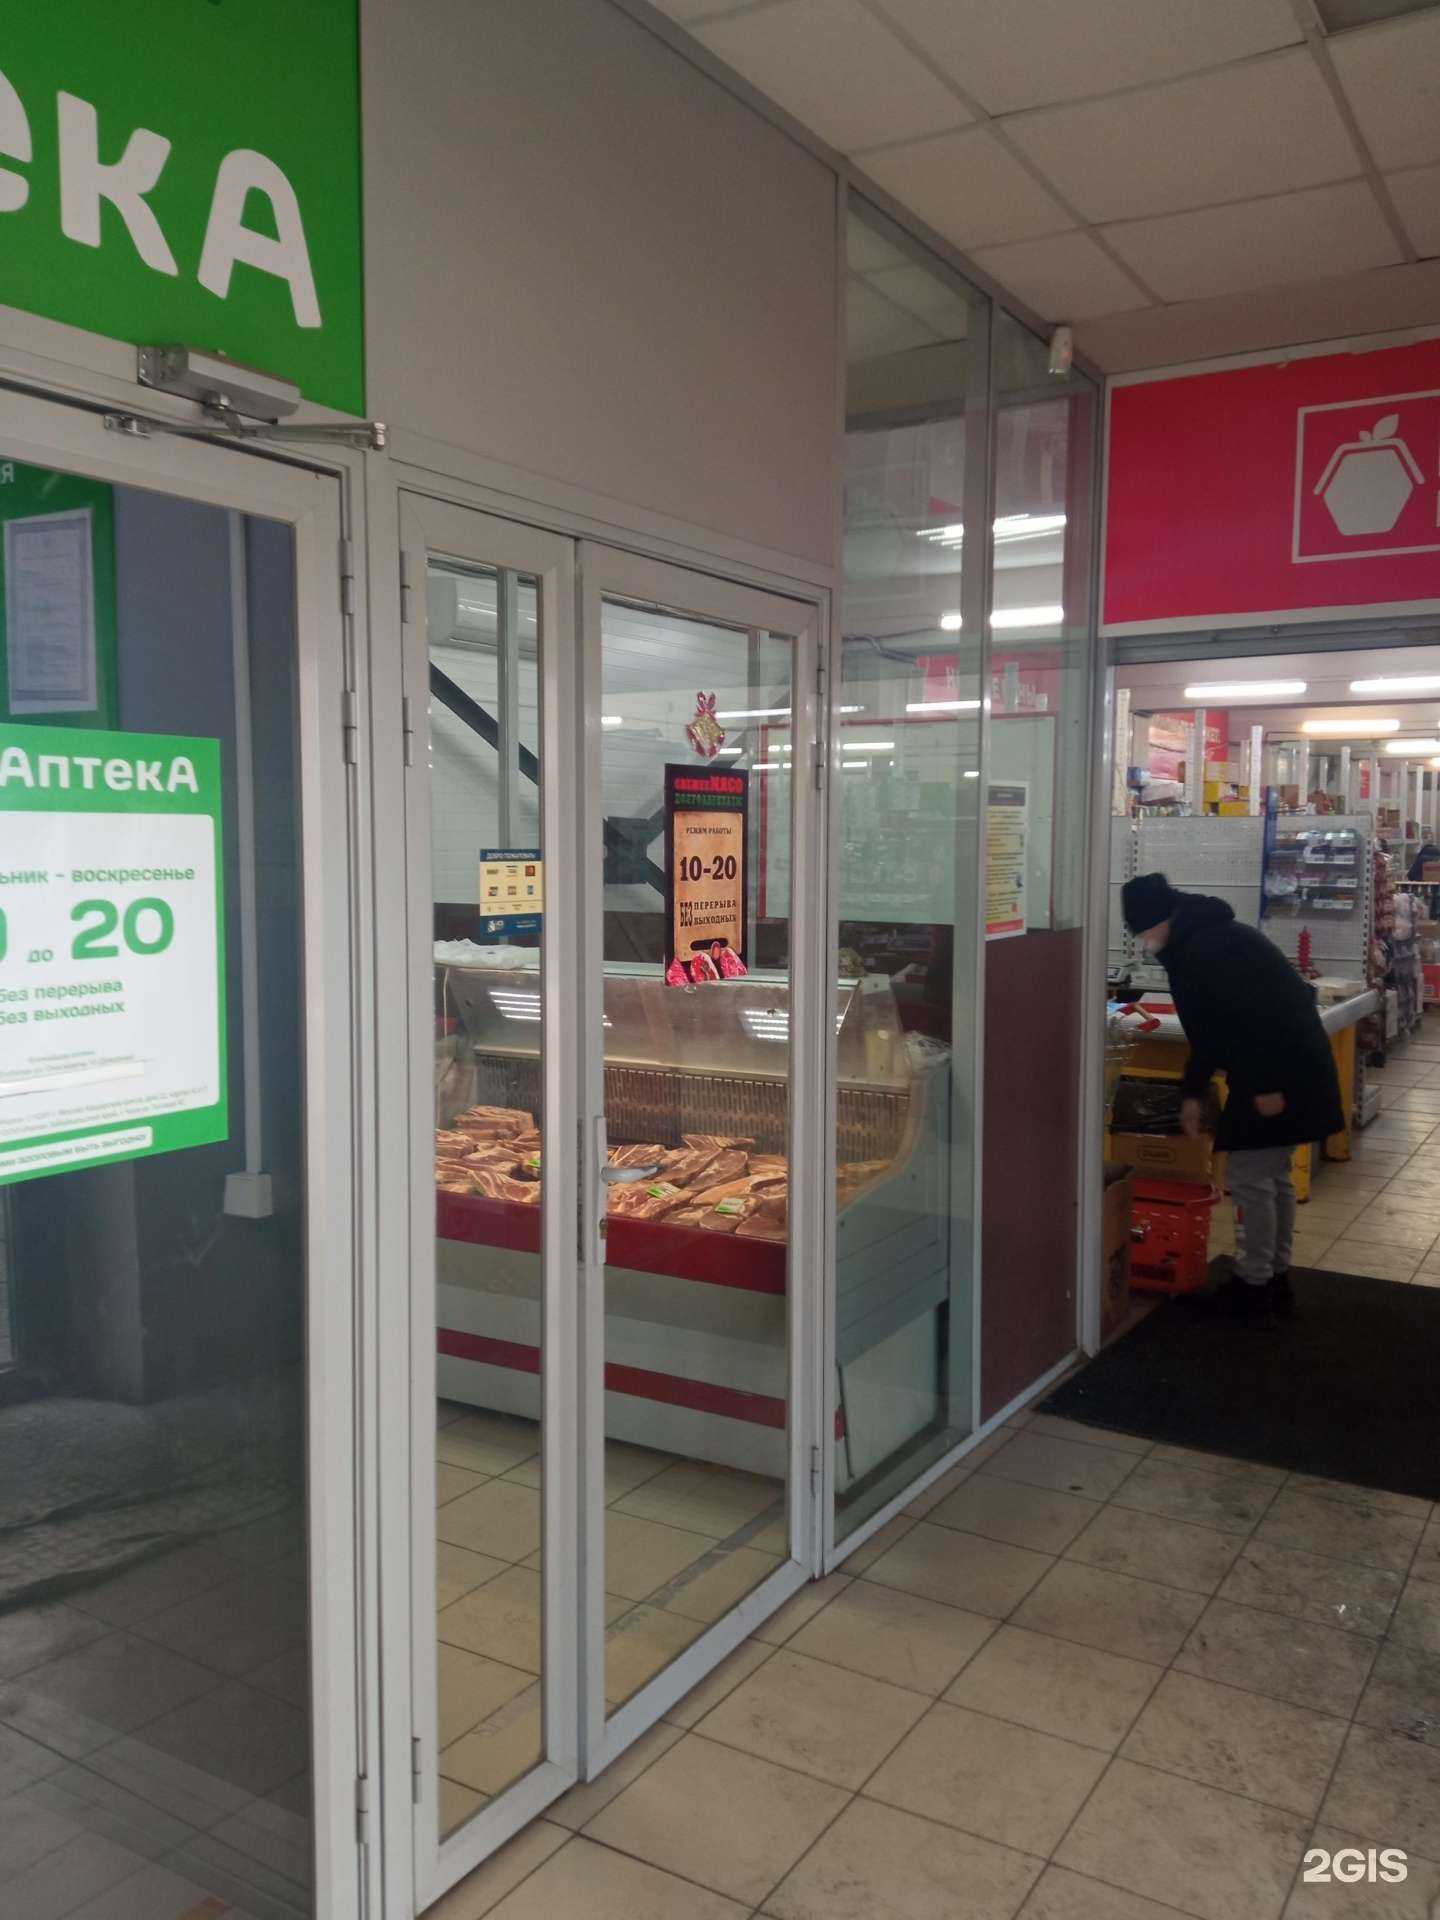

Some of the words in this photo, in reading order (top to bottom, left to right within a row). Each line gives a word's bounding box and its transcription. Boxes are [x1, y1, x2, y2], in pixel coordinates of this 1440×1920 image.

[71, 867, 195, 884] воскресенье
[680, 855, 737, 881] 10-20
[694, 900, 737, 910] ПЕРЕРЫВА
[28, 949, 54, 963] до
[70, 897, 174, 960] 20
[694, 914, 737, 926] ВЫХОДНЫХ
[35, 980, 124, 1000] перерыва
[34, 1002, 125, 1022] выходных
